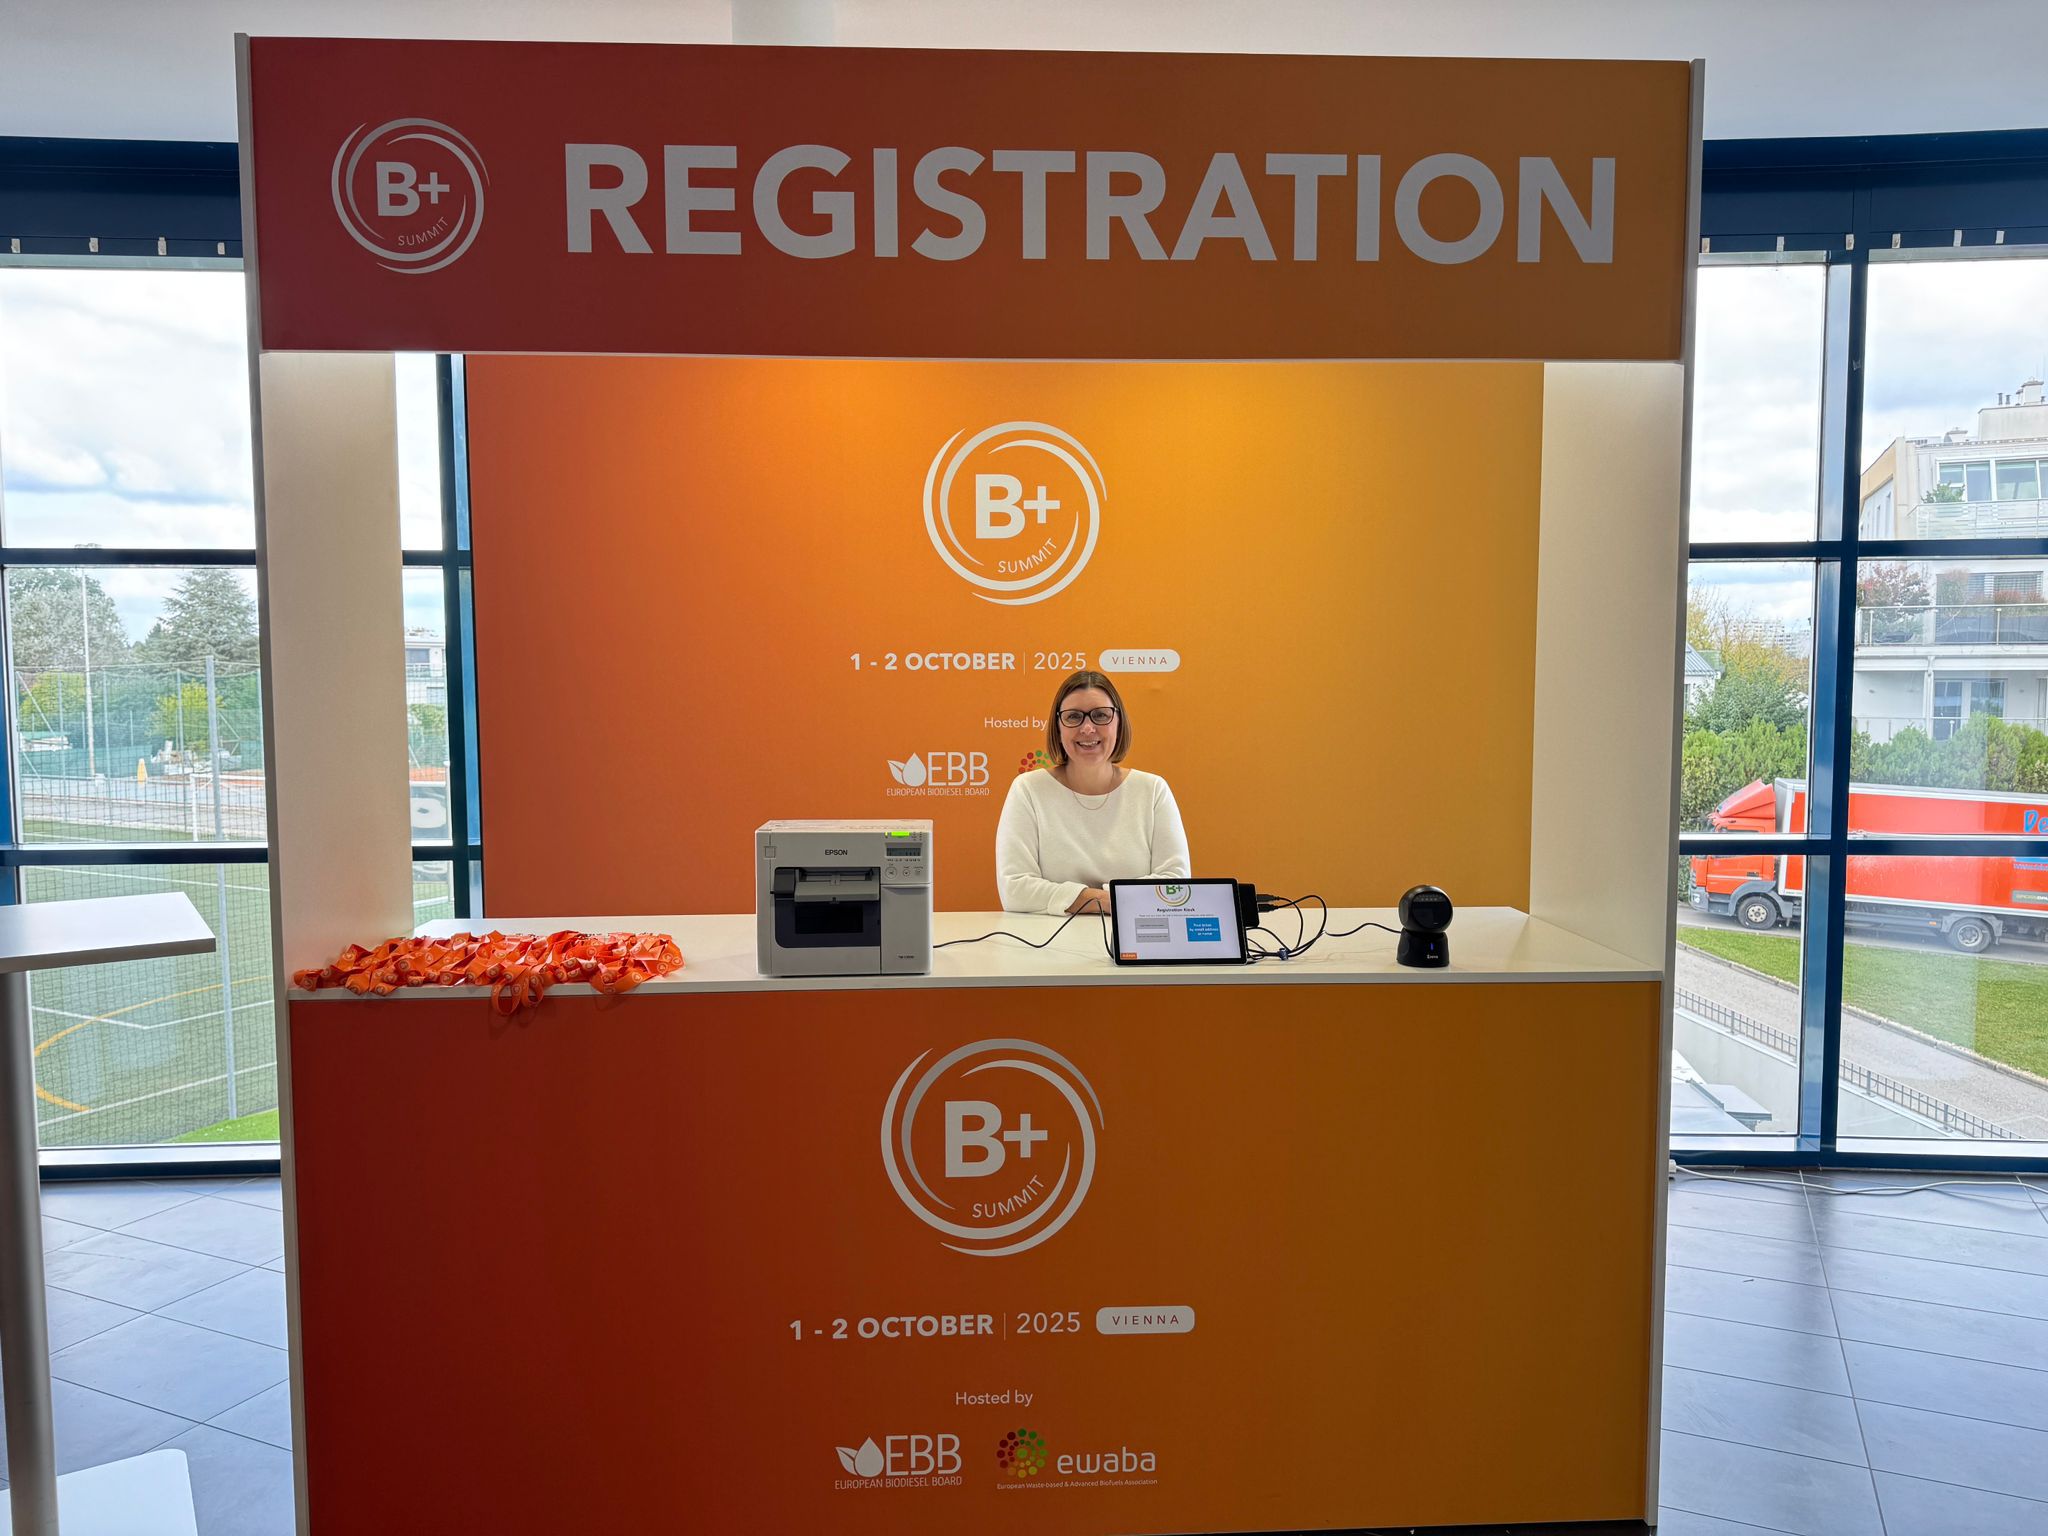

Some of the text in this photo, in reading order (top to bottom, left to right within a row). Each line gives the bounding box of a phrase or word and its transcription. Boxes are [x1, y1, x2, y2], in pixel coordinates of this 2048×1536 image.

[376, 161, 450, 217] B+
[564, 143, 1616, 265] REGISTRATION
[396, 216, 449, 247] SUMMIT
[975, 473, 1061, 539] B+
[997, 537, 1058, 574] SUMMIT
[850, 652, 861, 671] 1
[884, 652, 898, 671] 2
[904, 652, 1016, 671] OCTOBER
[1033, 651, 1087, 671] 2025
[1111, 656, 1168, 666] VIENNA
[984, 716, 1048, 732] Hosted by
[927, 751, 990, 786] EBB
[886, 787, 990, 797] EUROPEAN BIODIESEL BOARD
[944, 1100, 1049, 1178] B+
[972, 1174, 1046, 1219] SUMMIT
[789, 1320, 802, 1341] 1
[831, 1319, 849, 1340] 2
[857, 1314, 994, 1340] OCTOBER
[1016, 1311, 1081, 1334] 2025
[1111, 1314, 1180, 1327] VIENNA
[955, 1389, 1034, 1408] Hosted by
[885, 1433, 962, 1476] EBB
[1056, 1446, 1156, 1475] ewaba
[834, 1475, 963, 1491] EUROPEAN BIODIESEL BOARD
[996, 1483, 1025, 1491] European
[1026, 1481, 1064, 1489] Waste-based
[1070, 1480, 1099, 1488] Advanced
